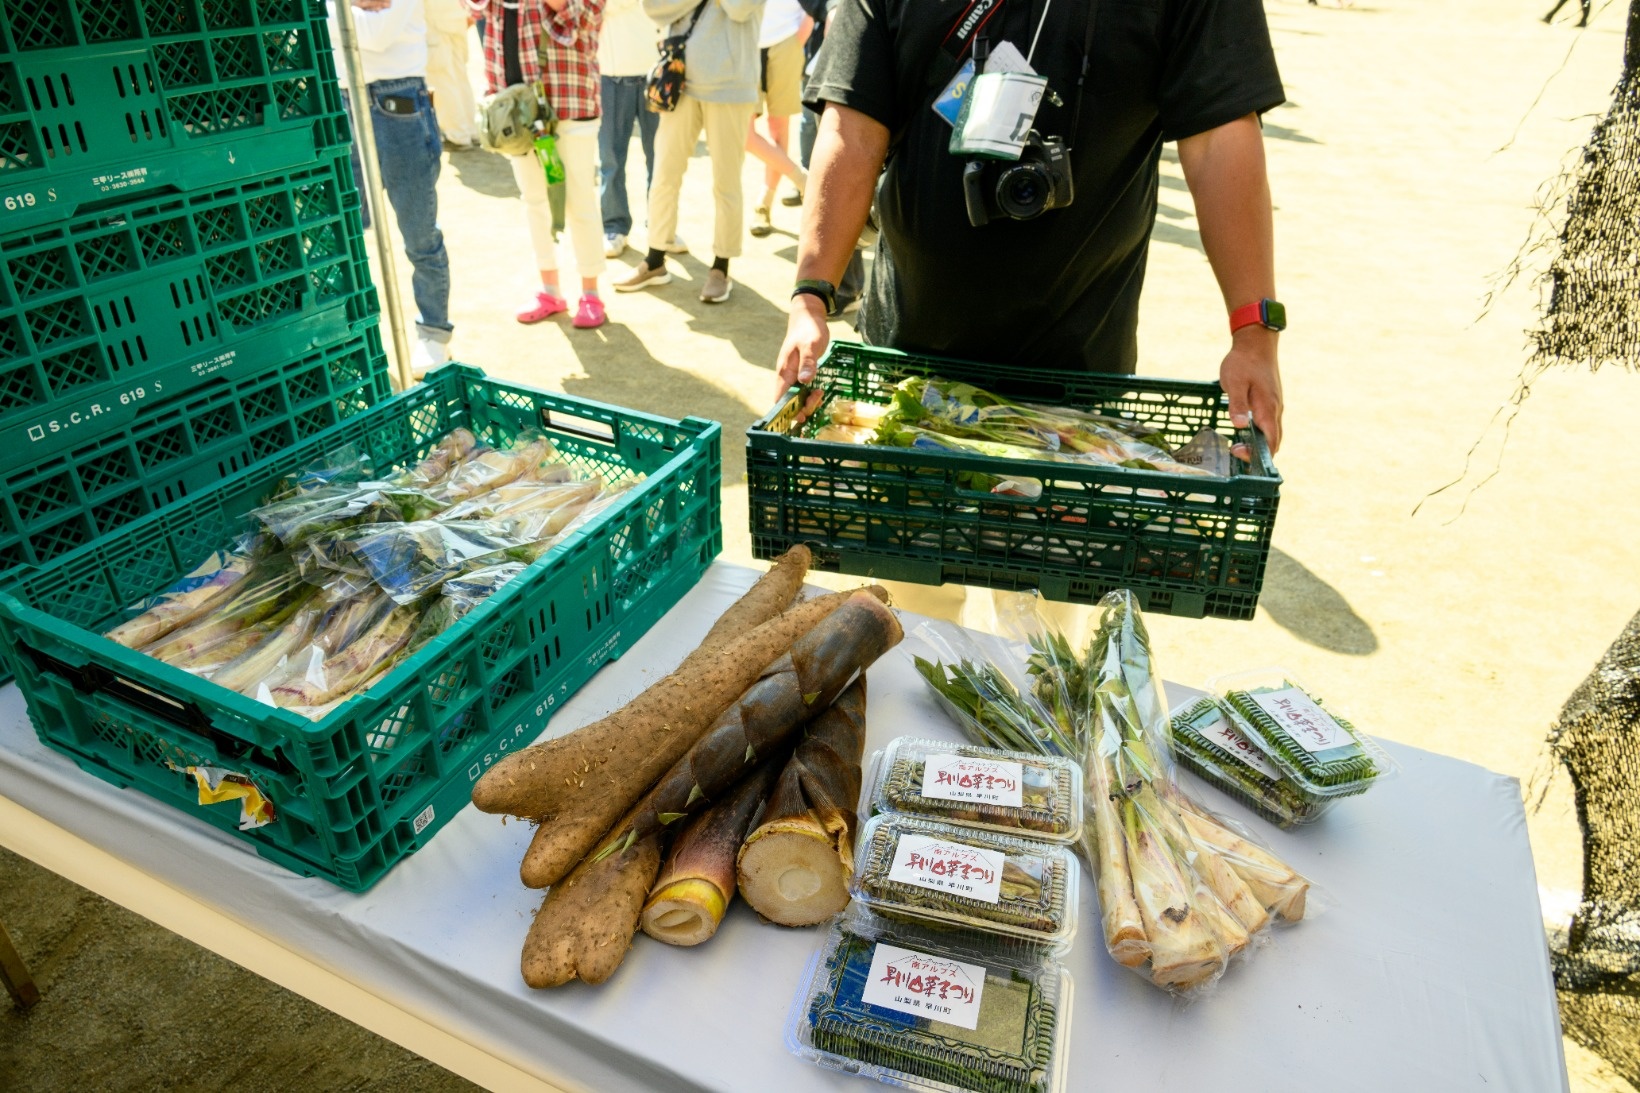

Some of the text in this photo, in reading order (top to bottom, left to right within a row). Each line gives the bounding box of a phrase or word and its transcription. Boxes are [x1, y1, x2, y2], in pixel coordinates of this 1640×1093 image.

[957, 0, 994, 39] Canon
[5, 187, 57, 210] 619 S
[120, 387, 145, 405] 619
[154, 380, 163, 392] S
[535, 693, 555, 717] 615
